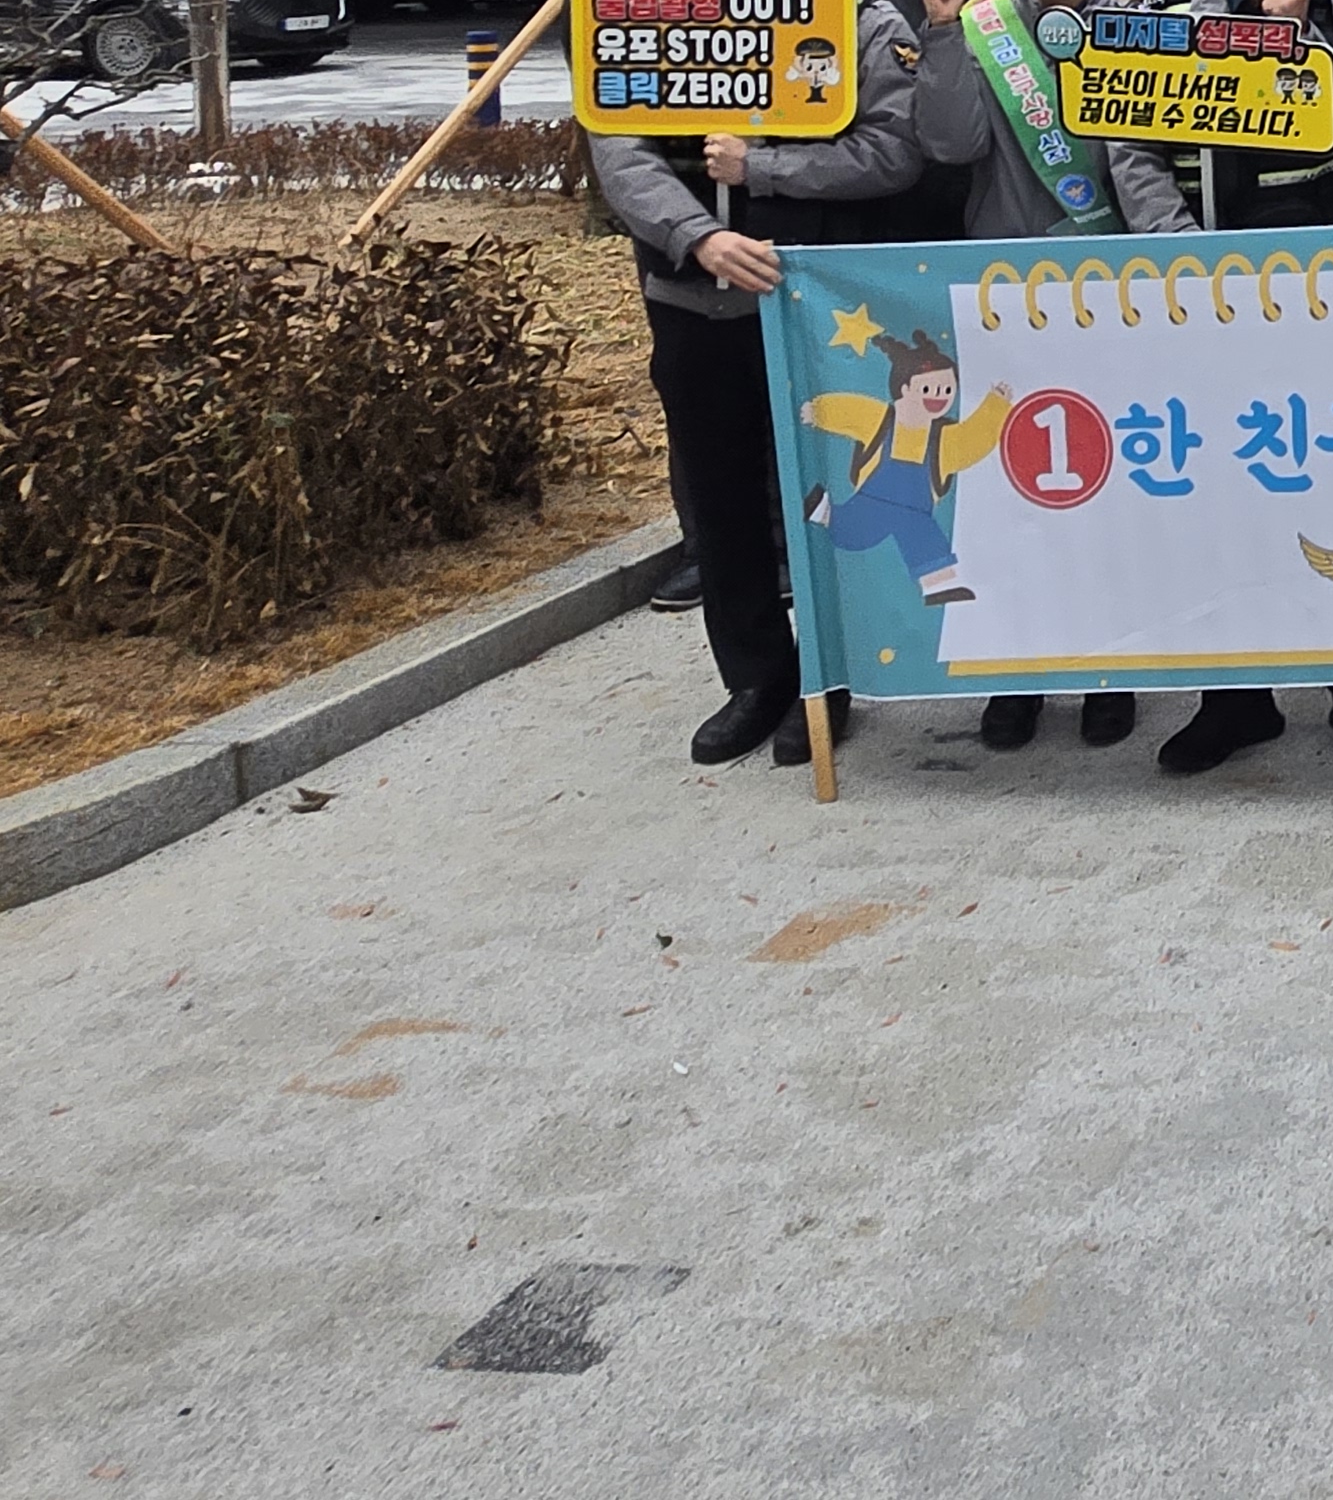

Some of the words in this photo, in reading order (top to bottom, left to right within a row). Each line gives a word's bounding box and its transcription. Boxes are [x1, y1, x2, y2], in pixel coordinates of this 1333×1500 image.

[597, 27, 659, 62] 유포
[666, 28, 770, 63] STOP!
[1094, 13, 1192, 52] 디지털
[598, 71, 659, 105] 클릭
[666, 71, 769, 105] ZERO!
[1081, 67, 1155, 99] 당신이
[1163, 72, 1241, 103] 나서면
[1161, 104, 1185, 130] 수
[1190, 104, 1302, 138] 있습니다.
